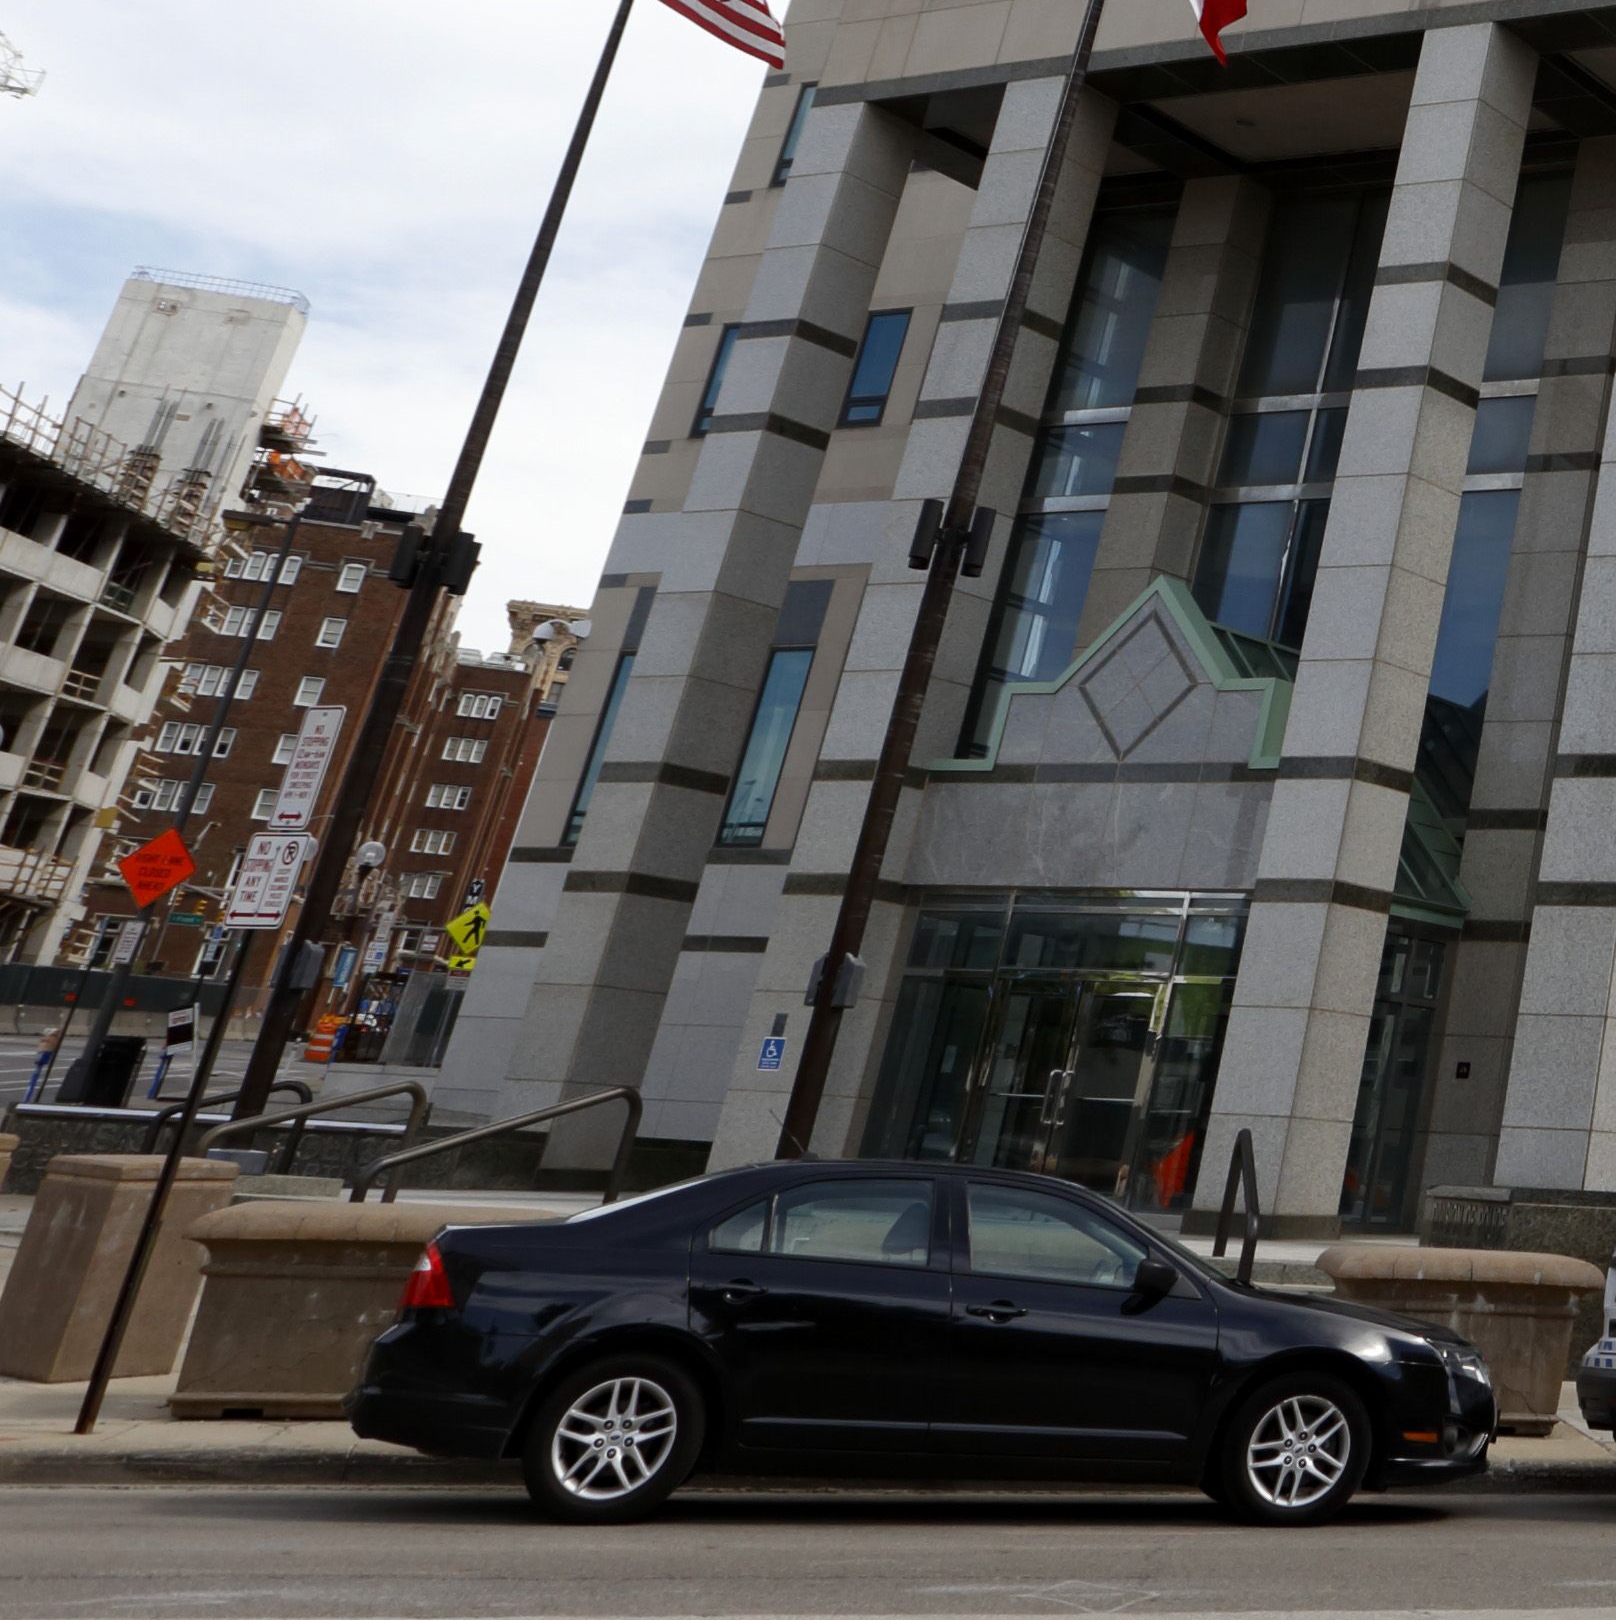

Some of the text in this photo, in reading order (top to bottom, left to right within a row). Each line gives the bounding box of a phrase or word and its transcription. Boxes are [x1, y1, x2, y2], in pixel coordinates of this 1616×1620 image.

[256, 841, 273, 855] NO
[243, 858, 275, 873] STOPPING
[244, 876, 263, 888] ANY
[239, 890, 259, 903] TIME
